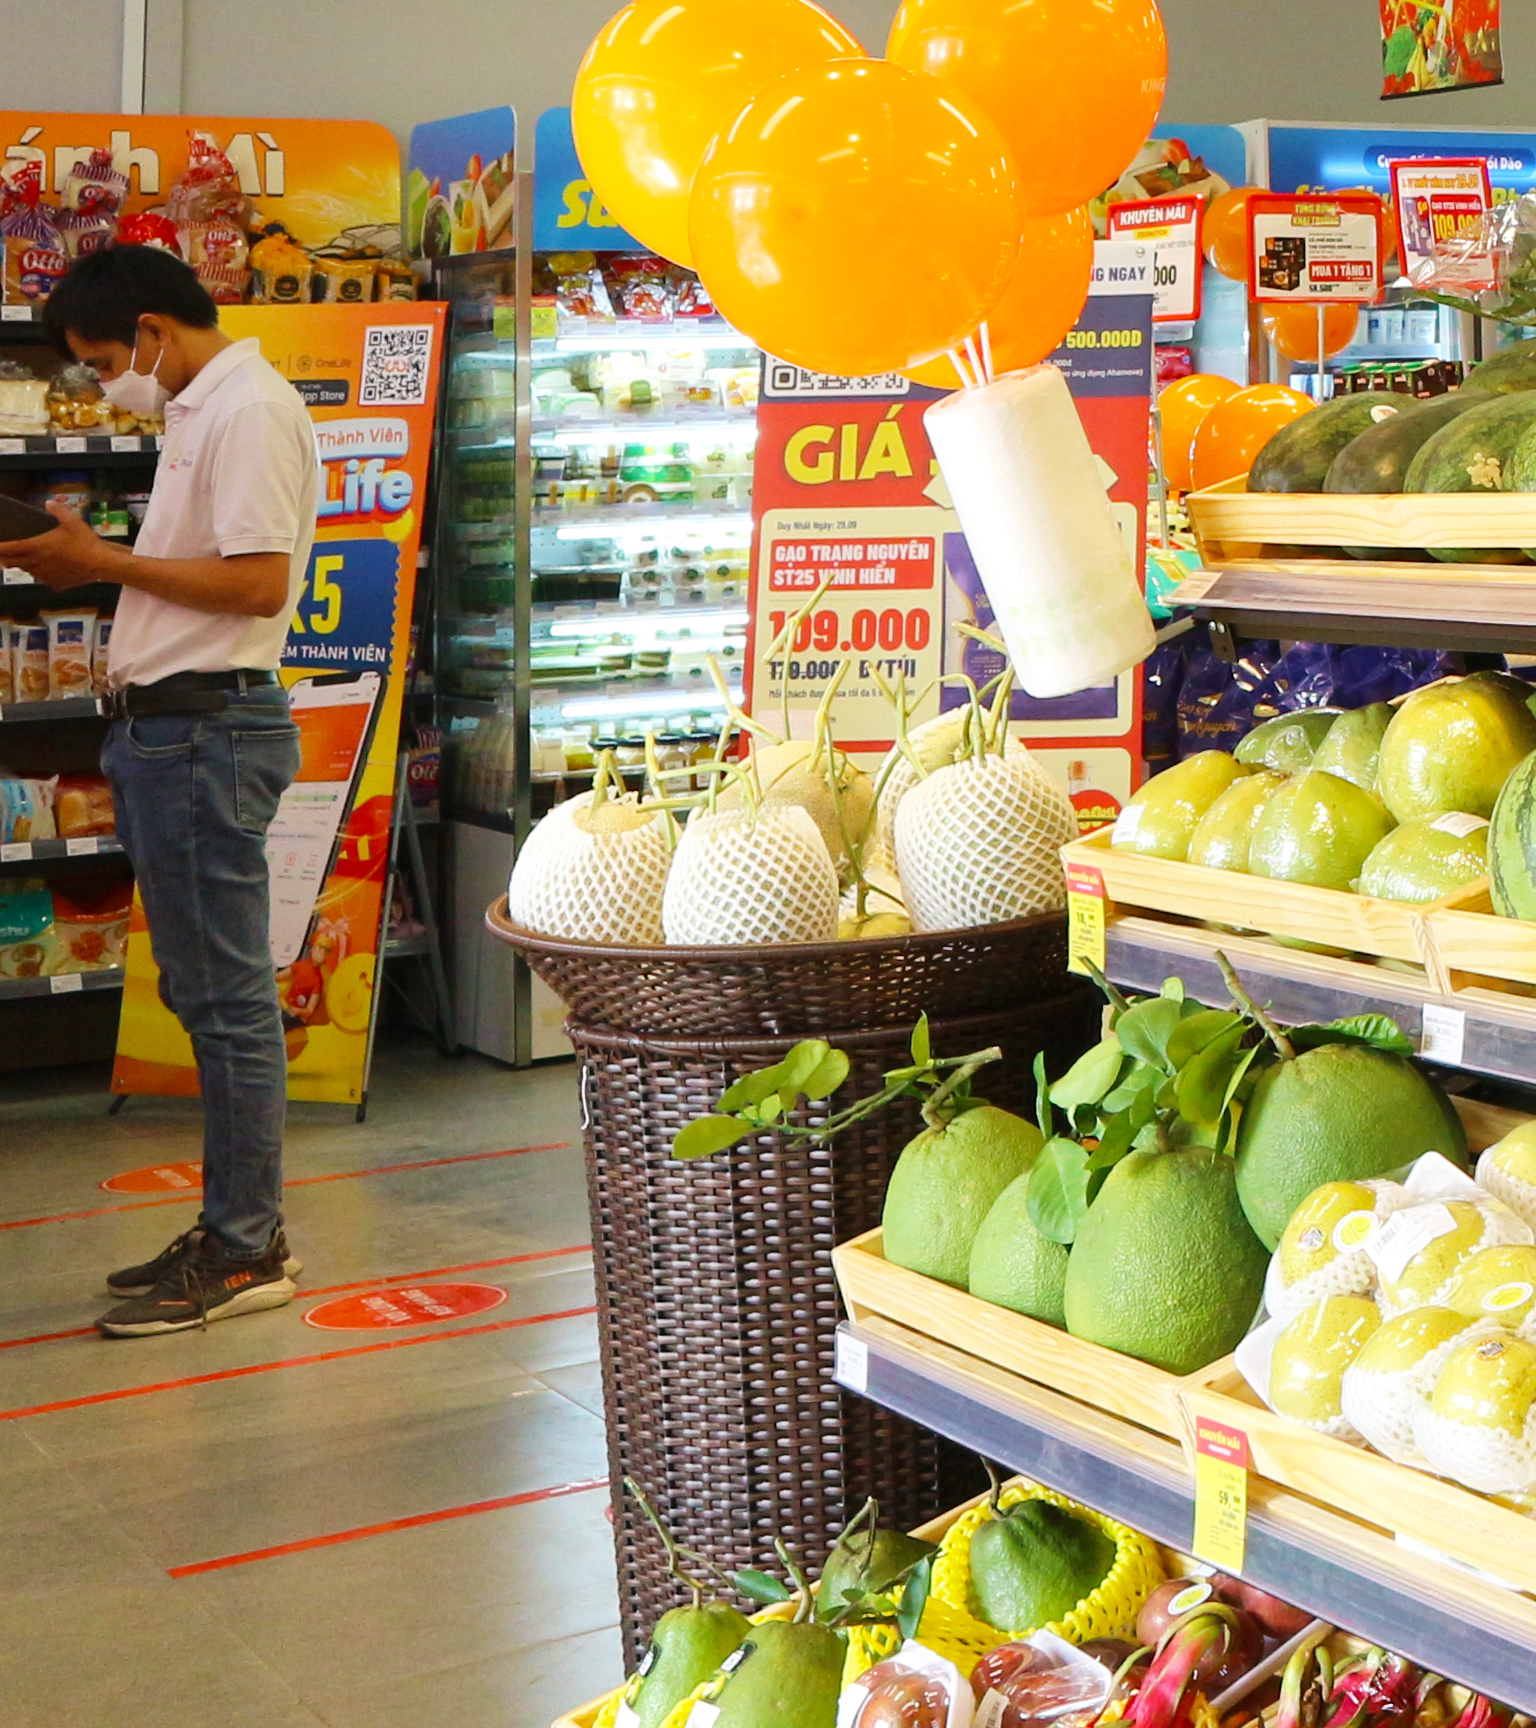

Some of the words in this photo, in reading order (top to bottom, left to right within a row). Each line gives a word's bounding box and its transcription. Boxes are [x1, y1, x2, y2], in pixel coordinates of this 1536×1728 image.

[1108, 266, 1147, 282] NGAY
[1311, 264, 1332, 277] MUA
[320, 390, 345, 401] Store
[317, 428, 365, 448] Thành
[784, 403, 913, 485] GIÁ
[775, 545, 807, 568] GẠO
[811, 544, 864, 567] TRẠNG
[867, 539, 929, 561] NGUYÊN
[774, 569, 815, 586] ST25
[859, 562, 896, 584] HIỂN
[301, 643, 348, 660] THÀNH
[352, 643, 386, 662] VIÊN
